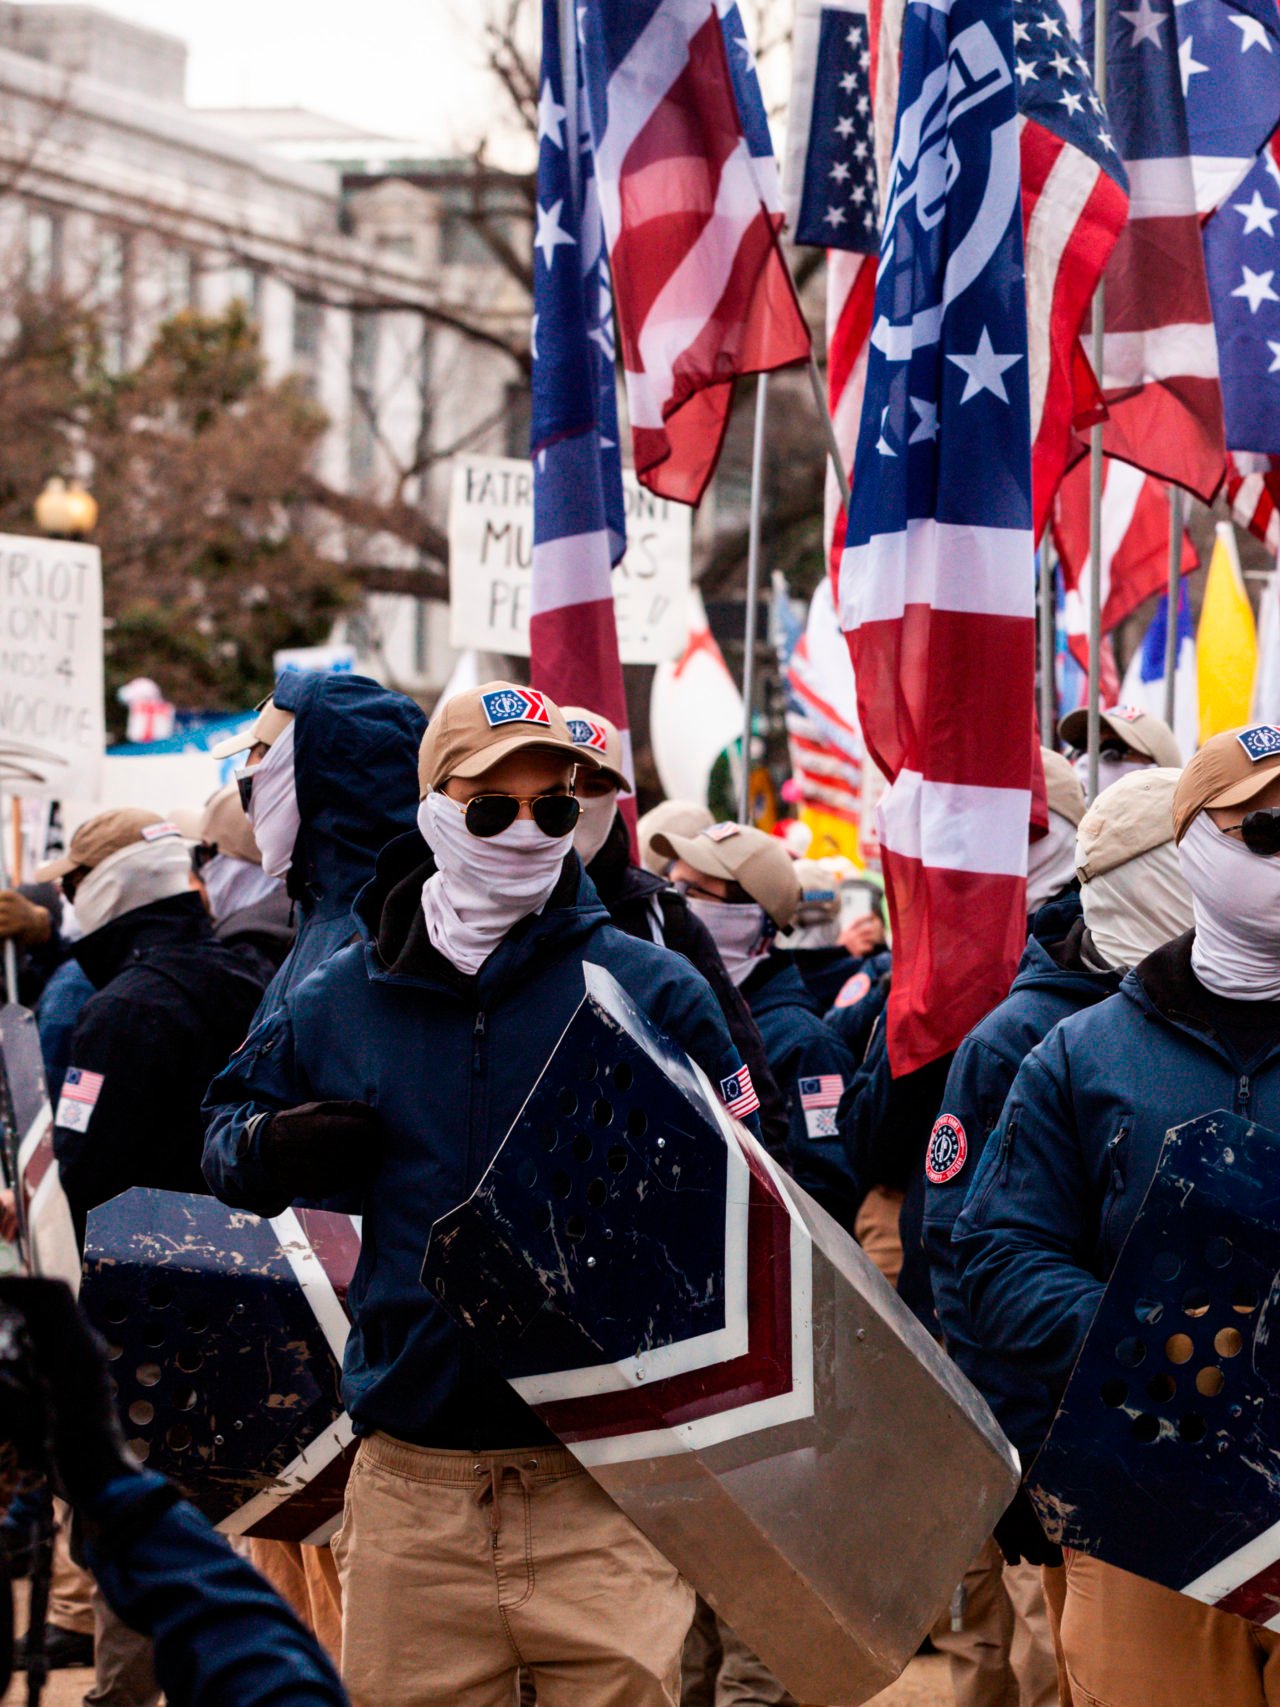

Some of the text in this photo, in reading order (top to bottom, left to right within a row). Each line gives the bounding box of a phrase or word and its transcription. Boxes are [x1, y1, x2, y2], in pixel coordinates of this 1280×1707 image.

[0, 552, 88, 606] RIOT
[0, 604, 80, 651] ONT
[54, 655, 76, 688] 4
